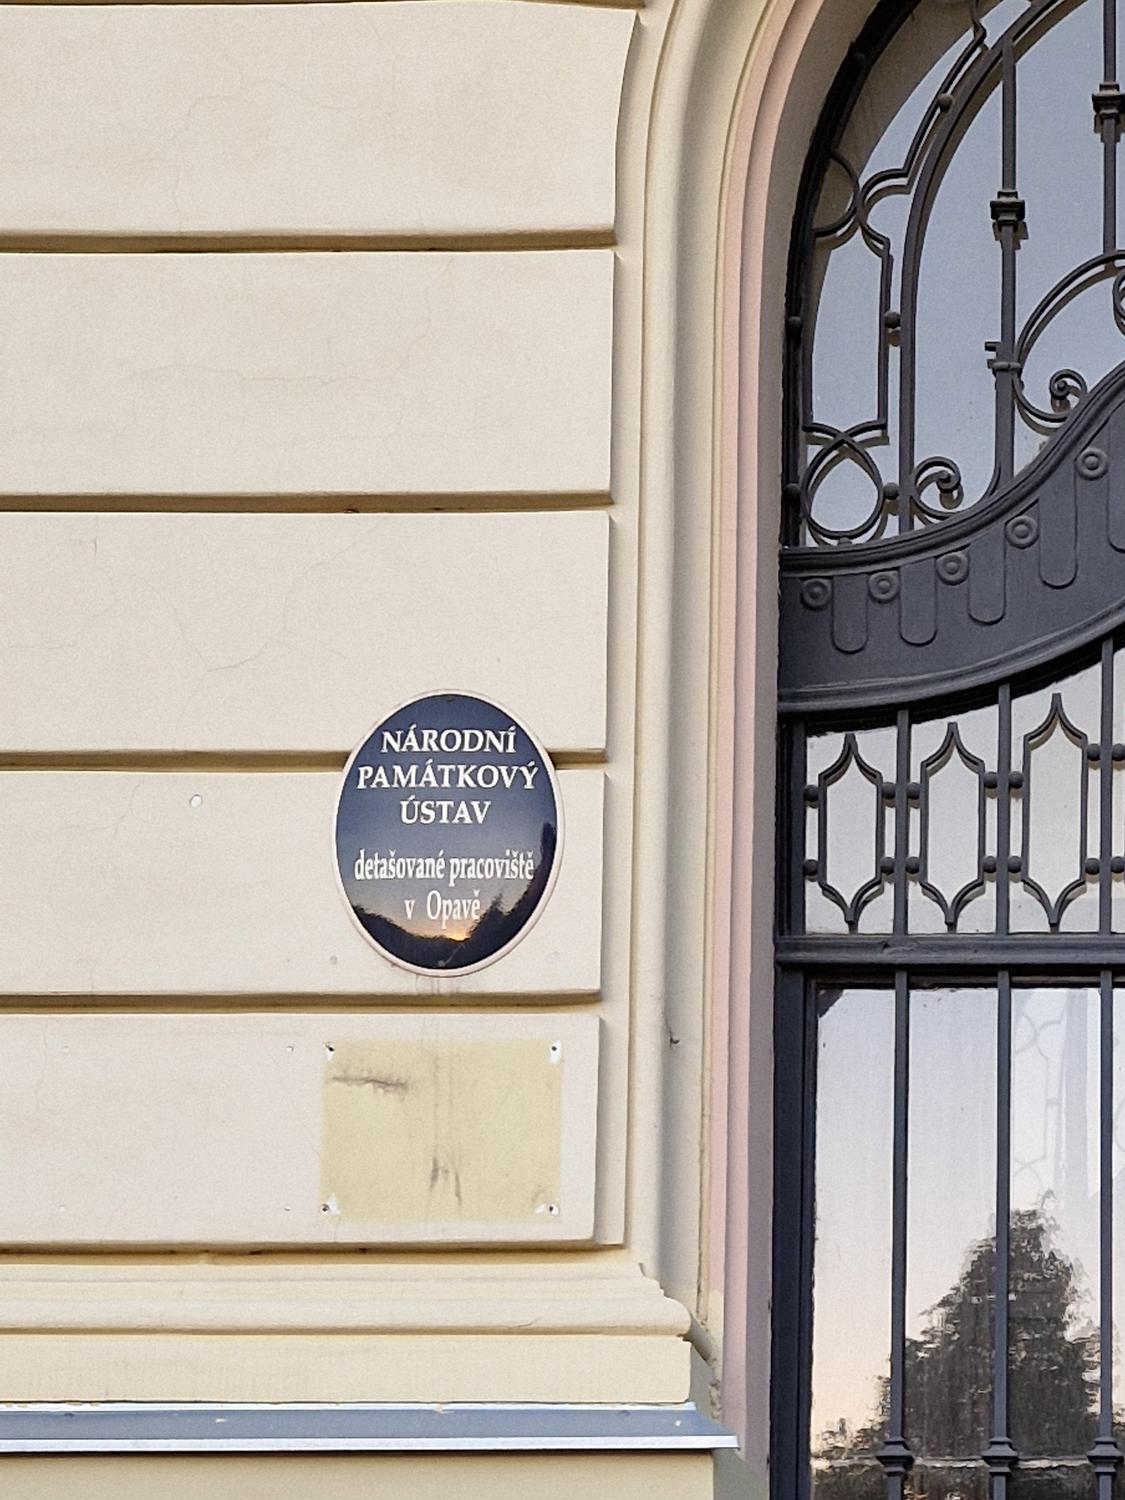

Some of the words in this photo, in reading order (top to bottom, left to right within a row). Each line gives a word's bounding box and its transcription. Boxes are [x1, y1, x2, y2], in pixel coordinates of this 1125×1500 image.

[380, 724, 518, 753] NÁRODNÍ
[356, 759, 539, 789] PAMÁTKOVÝ
[399, 795, 491, 825] ÚSTAV
[354, 849, 446, 881] detašované
[448, 850, 534, 887] pracoviště
[404, 900, 416, 919] v
[426, 889, 482, 930] Opavě
